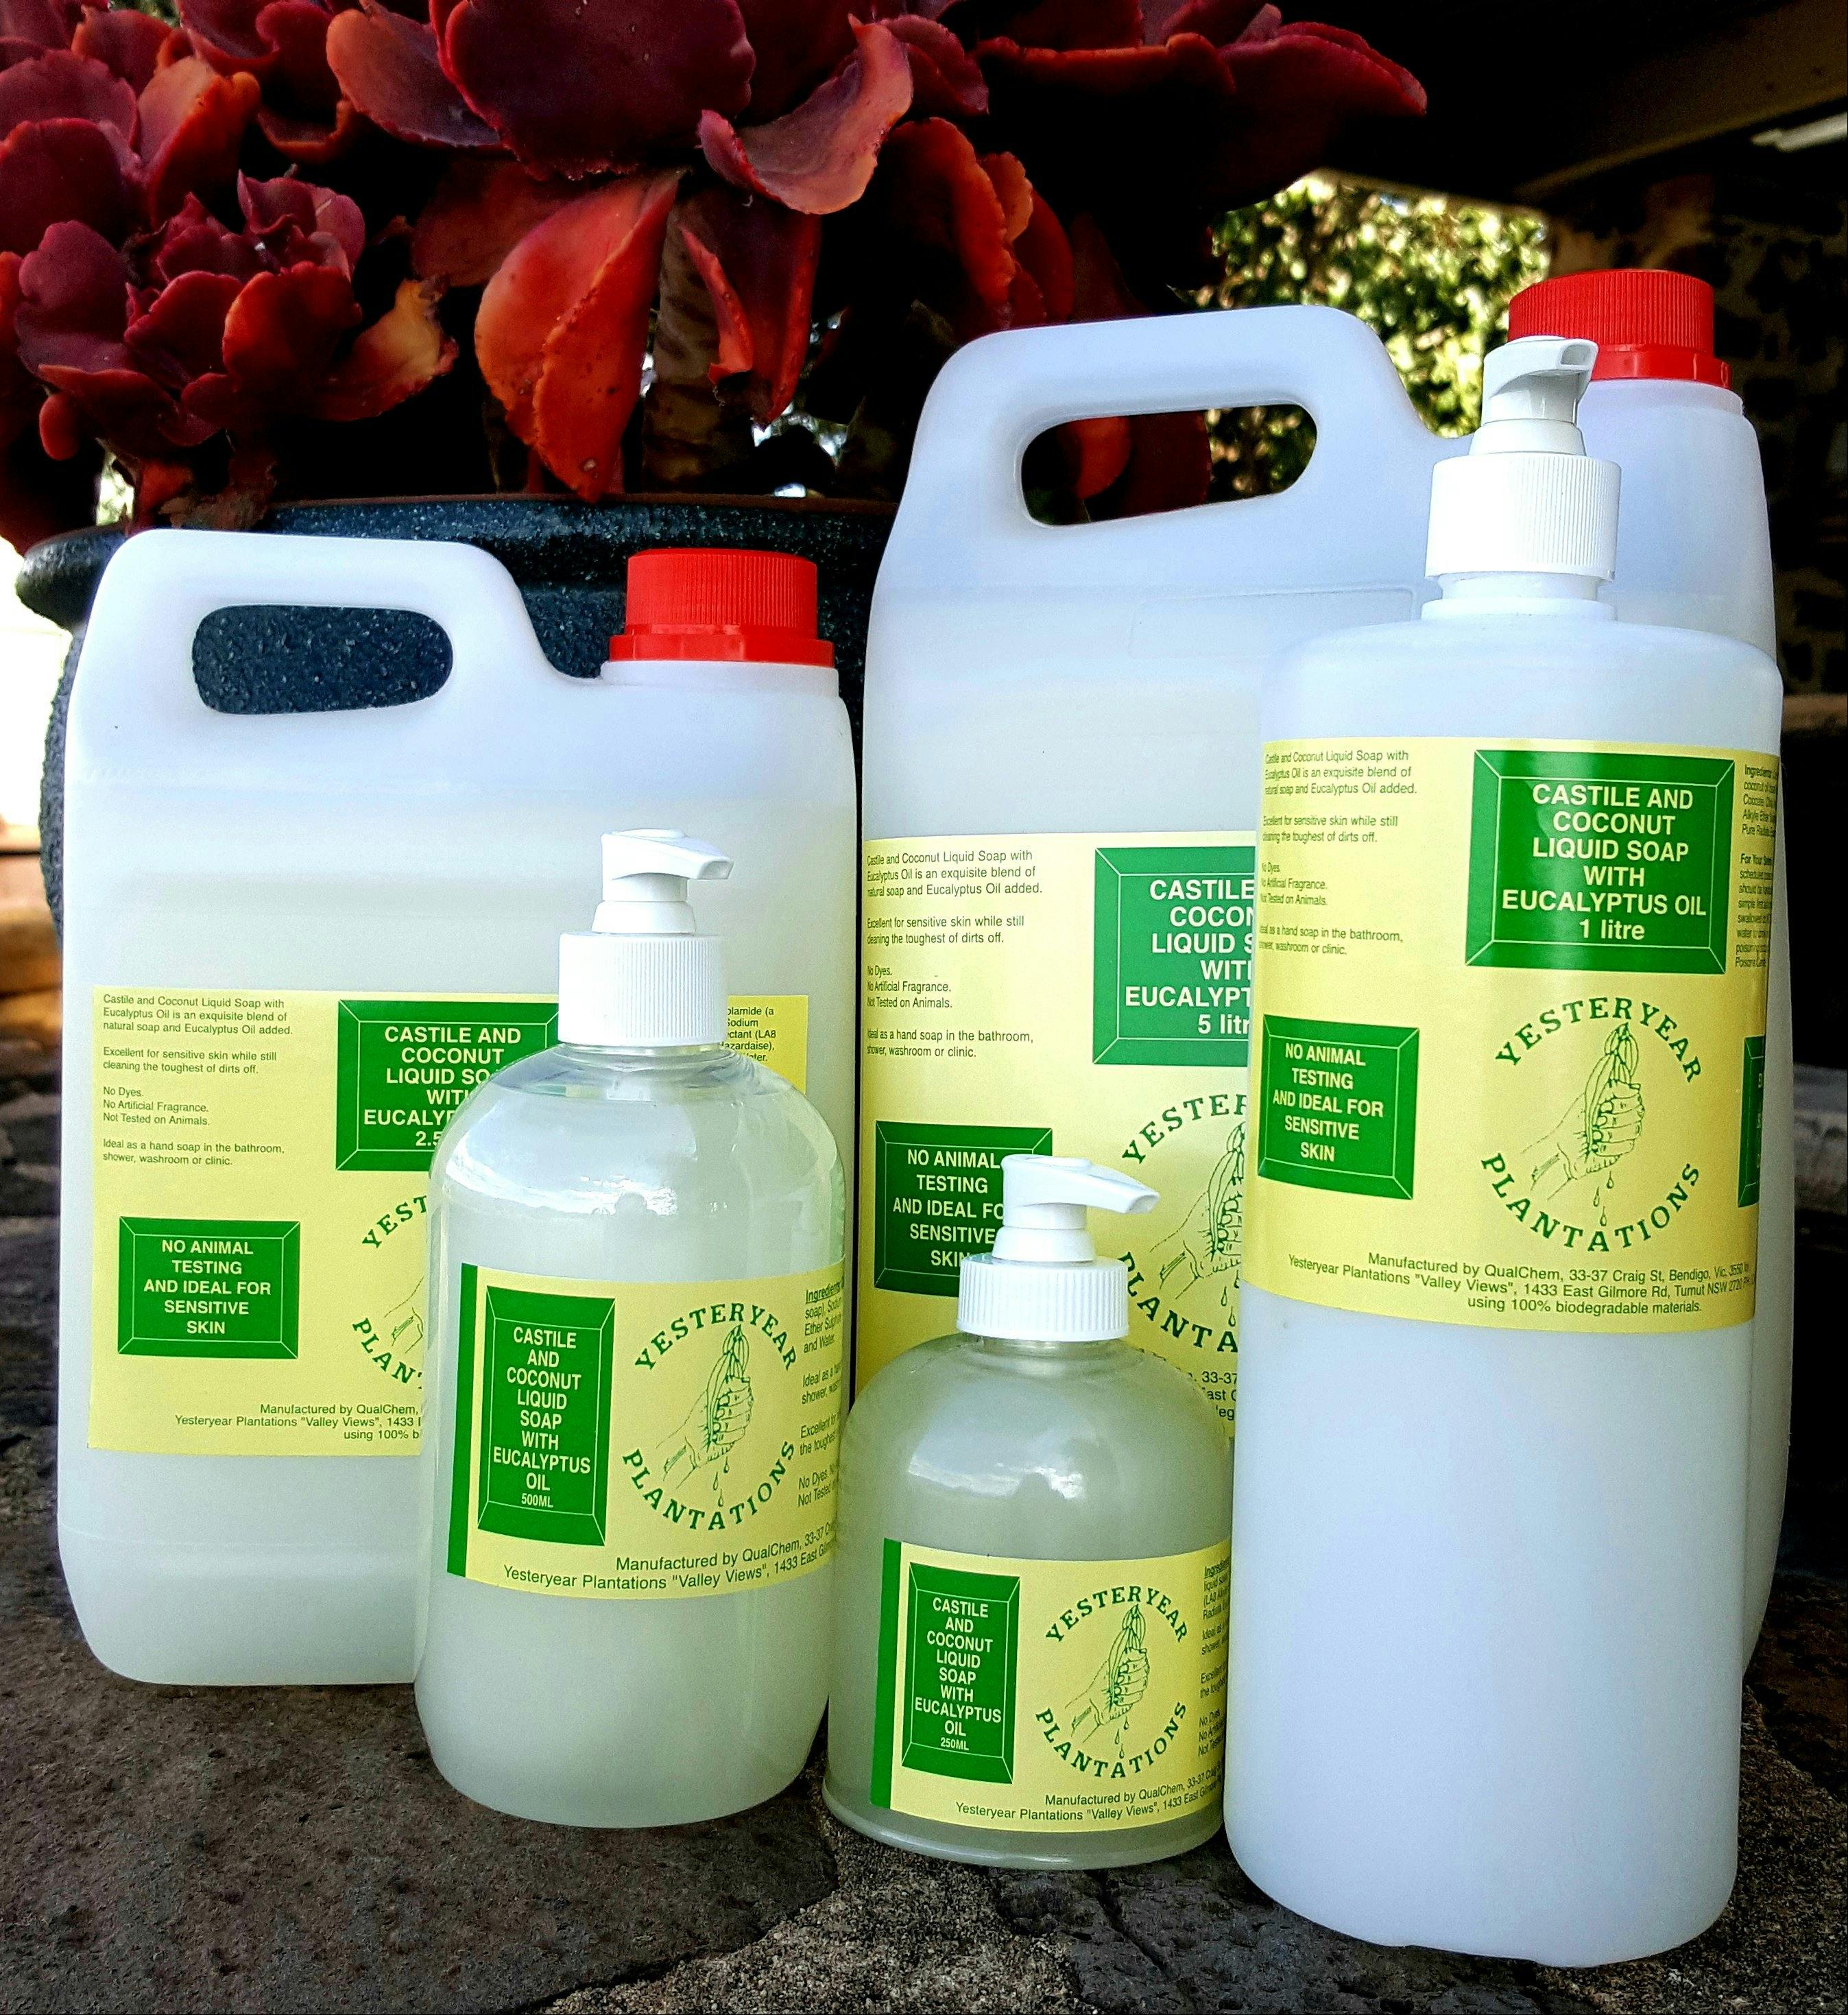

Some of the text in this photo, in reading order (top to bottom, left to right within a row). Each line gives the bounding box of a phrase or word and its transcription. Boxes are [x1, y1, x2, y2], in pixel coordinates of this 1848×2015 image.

[1533, 784, 1693, 809] CASTILE AND
[1553, 811, 1675, 835] COCONUT
[1533, 837, 1689, 861] LIQUID SOAP
[1583, 866, 1645, 887] WITH
[1150, 879, 1255, 901] CASTILE
[1502, 890, 1707, 916] EUCALYPTUS OIL
[894, 917, 904, 927] for
[907, 916, 947, 927] sensitive
[950, 916, 971, 927] skin
[975, 916, 1002, 927] while
[1006, 916, 1024, 927] still
[1579, 919, 1645, 940] 1 litre
[1152, 933, 1236, 953] LIQUID
[104, 994, 285, 1009] Castile and Coconut Liquid Soap with
[104, 1008, 287, 1021] Eucalyptus Oil is an exquisite blend of
[103, 1022, 293, 1035] natural soap and Eucalyptus Oil added.
[384, 1026, 521, 1044] CASTILE AND
[1495, 996, 1703, 1084] YESTERYEAR
[401, 1047, 505, 1064] COCONUT
[1285, 1042, 1366, 1066] NO ANIMAL
[103, 1061, 259, 1074] cleaning the toughest of dirts off.
[386, 1068, 491, 1085] LIQUID SO
[1292, 1067, 1354, 1090] TESTING
[1273, 1089, 1384, 1118] AND IDEAL FOR
[1285, 1114, 1359, 1141] SENSITIVE
[103, 1138, 123, 1148] Ideal
[149, 1141, 173, 1150] hand
[177, 1143, 200, 1153] soap
[204, 1143, 212, 1152] in
[215, 1143, 230, 1152] the
[235, 1143, 285, 1154] bathroom,
[1300, 1141, 1335, 1162] SKIN
[907, 1149, 1000, 1169] NO ANIMAL
[916, 1174, 988, 1193] TESTING
[893, 1197, 977, 1218] AND IDEAL
[1481, 1152, 1701, 1254] PLANTATIONS
[910, 1223, 996, 1244] SENSITIVE
[162, 1240, 254, 1254] NO ANIMAL
[172, 1260, 242, 1274] TESTING
[1288, 1254, 1339, 1274] Yesteryear
[1343, 1264, 1411, 1285] Plantations
[1415, 1274, 1461, 1292] "Valley
[1466, 1279, 1517, 1296] Views",
[1524, 1284, 1558, 1296] 1433
[1563, 1285, 1594, 1297] East
[1598, 1285, 1647, 1298] Gilmore
[1652, 1285, 1670, 1298] Rd,
[1707, 1282, 1727, 1296] NSW
[1368, 1252, 1457, 1274] Manufactured
[1463, 1262, 1480, 1278] by
[1485, 1264, 1563, 1283] QualChem,
[1569, 1269, 1607, 1281] 33-37
[1613, 1269, 1645, 1285] Craig
[1650, 1269, 1665, 1283] St,
[1669, 1268, 1711, 1281] Bendigo,
[143, 1279, 272, 1295] AND IDEAL FOR
[164, 1300, 249, 1315] SENSITIVE
[1467, 1296, 1702, 1317] using 100% biodegradable materials.
[187, 1320, 226, 1334] SKIN
[634, 1302, 797, 1372] YESTERYEAR
[513, 1326, 577, 1350] CASTILE
[527, 1348, 560, 1368] AND
[506, 1368, 582, 1390] COCONUT
[517, 1388, 568, 1411] LIQUID
[260, 1405, 419, 1416] Manufactured by QualChem,
[520, 1409, 562, 1430] SOAP
[176, 1415, 414, 1429] Yesteryear Plantations "Valley Views", 1433
[344, 1429, 409, 1441] using 100%
[521, 1430, 559, 1451] WITH
[493, 1446, 591, 1475] EUCALYPTUS
[526, 1472, 551, 1492] OIL
[623, 1440, 795, 1531] PLANTATIONS
[520, 1493, 554, 1508] 500ML
[616, 1527, 824, 1571] Manufactured by QualChem, 33-37
[504, 1551, 818, 1590] Yesteryear Plantations "Valley Views", 1433 East
[933, 1597, 989, 1618] CASTILE
[1045, 1586, 1188, 1643] YESTERYEAR
[945, 1616, 974, 1633] AND
[926, 1632, 993, 1653] COCONUT
[936, 1649, 981, 1669] LIQUID
[939, 1667, 976, 1684] SOAP
[940, 1684, 974, 1702] WITH
[914, 1697, 1002, 1723] EUCALYPTUS
[944, 1719, 967, 1736] OIL
[940, 1738, 970, 1751] 250ML
[1036, 1702, 1187, 1779] PLANTATIONS
[1045, 1774, 1205, 1806] Manufactured by QualChem, 33-37
[956, 1791, 1198, 1820] Yesteryear Plantations "Valley Views", 1433 East
